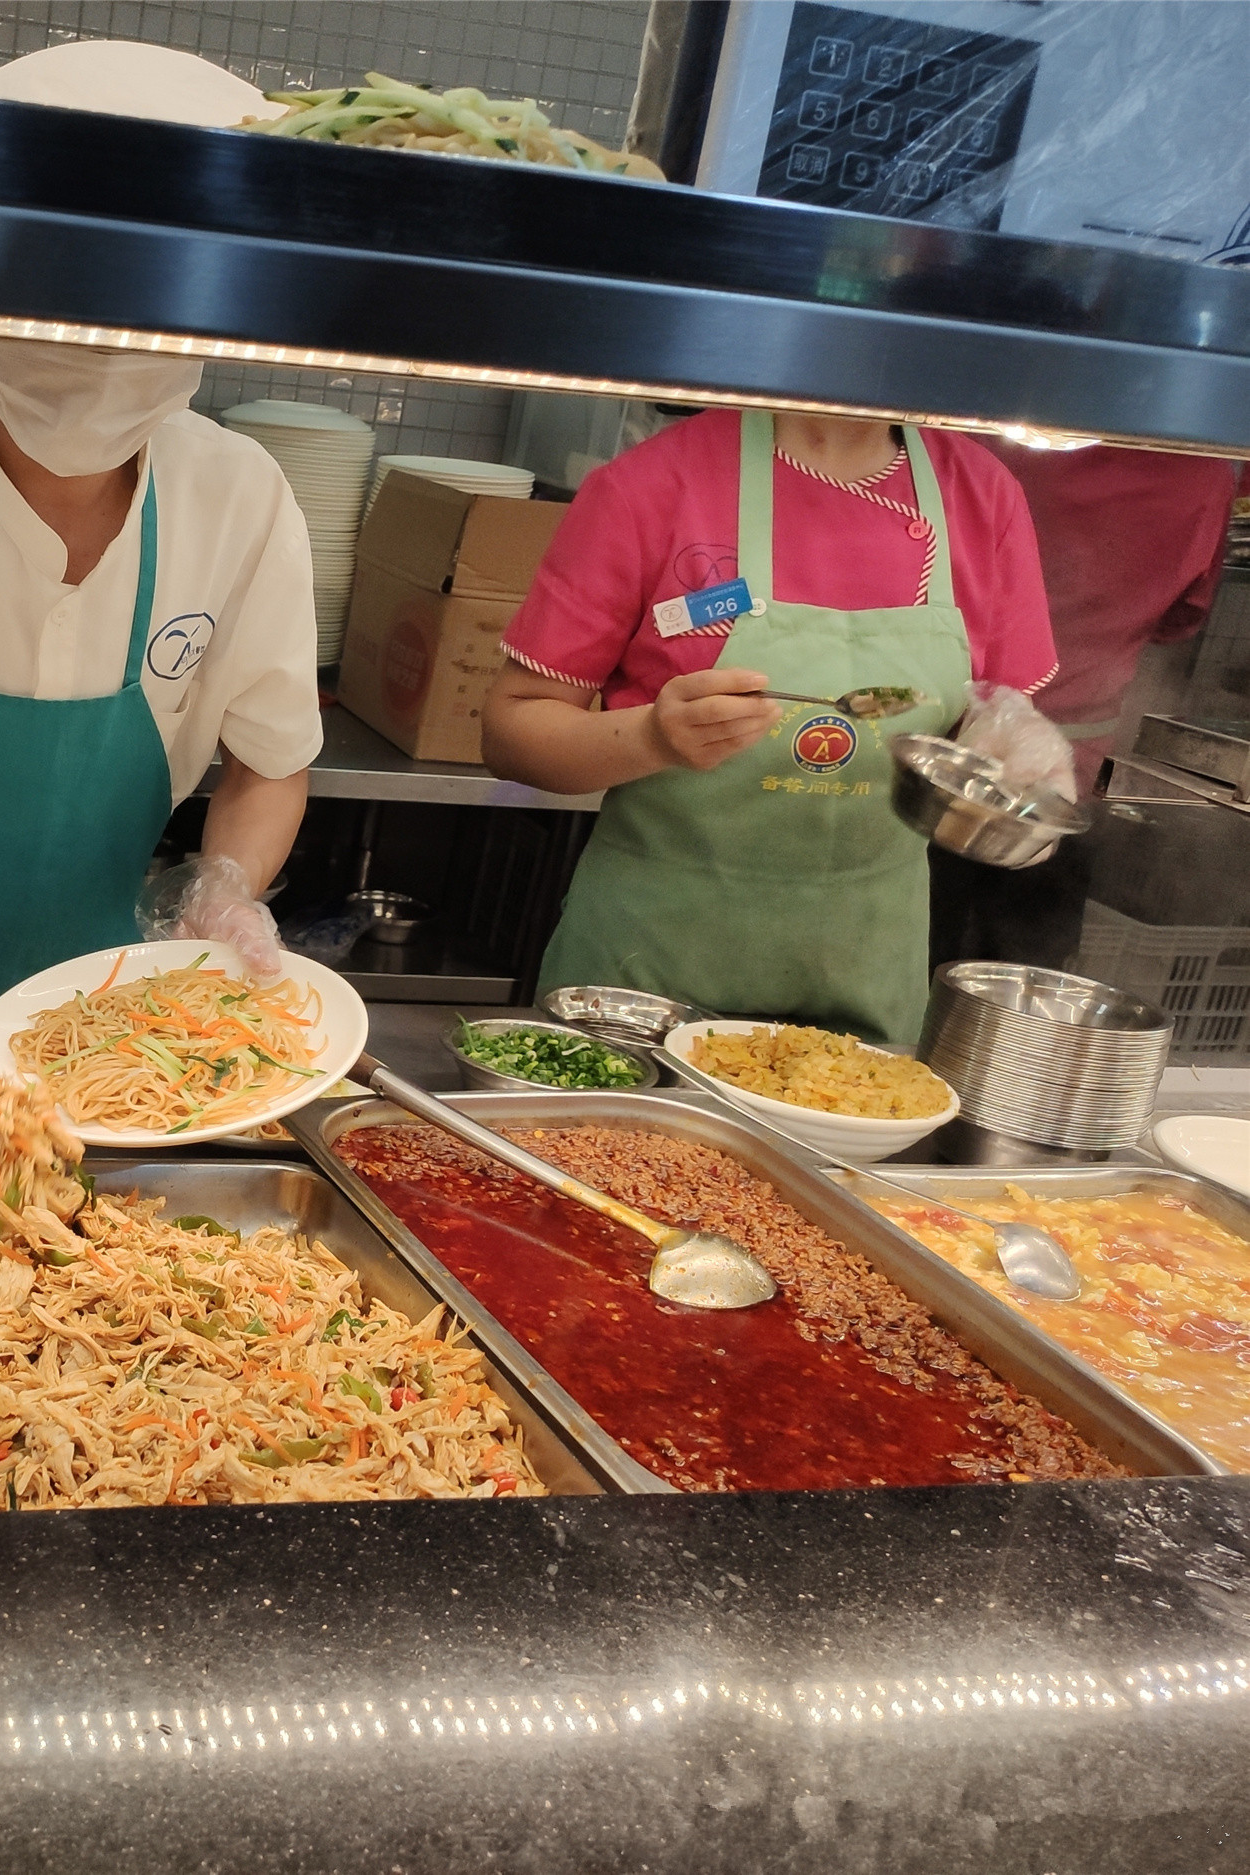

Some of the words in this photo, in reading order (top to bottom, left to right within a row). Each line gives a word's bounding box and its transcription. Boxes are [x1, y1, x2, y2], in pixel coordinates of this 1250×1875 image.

[878, 56, 894, 78] 2
[813, 101, 827, 121] 5
[866, 109, 879, 130] 6
[855, 162, 868, 182] 9
[704, 597, 738, 618] 126
